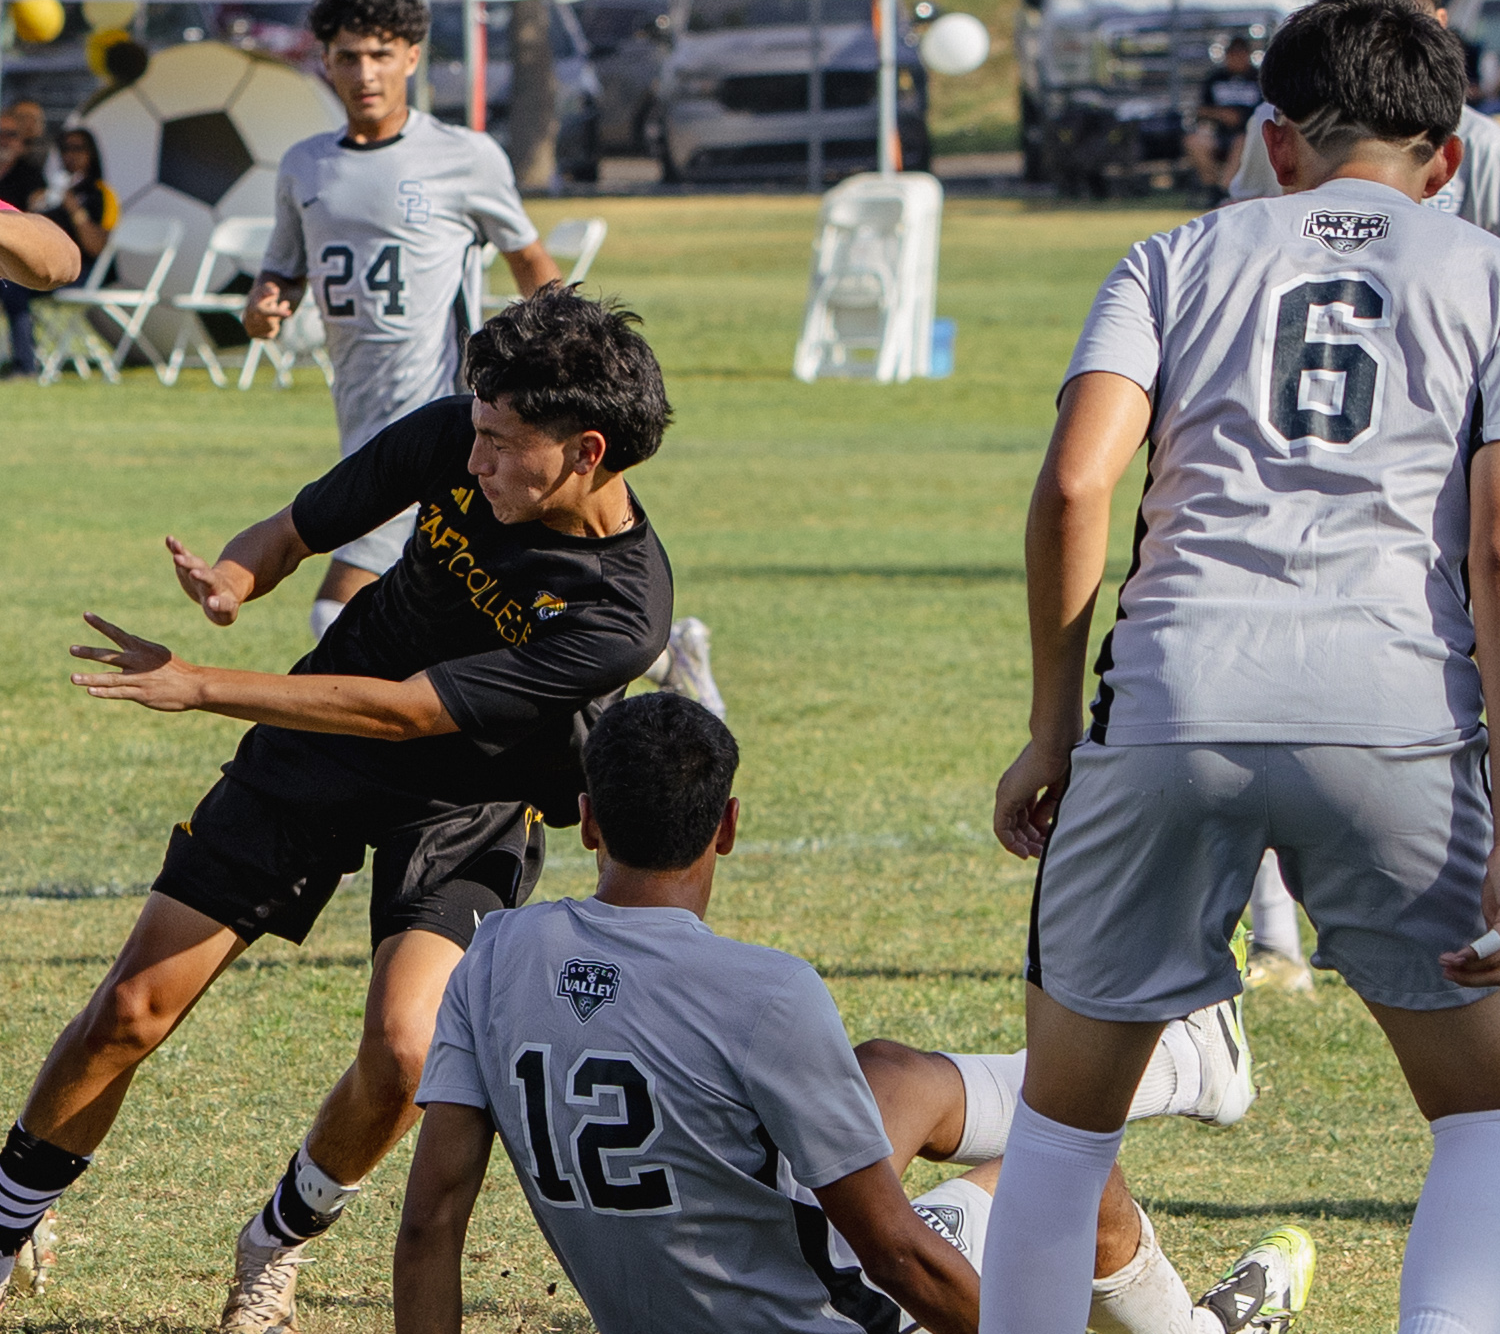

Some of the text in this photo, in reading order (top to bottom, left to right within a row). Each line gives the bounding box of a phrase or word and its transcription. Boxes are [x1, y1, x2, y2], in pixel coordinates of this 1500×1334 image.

[1318, 216, 1379, 226] SOCCER
[1311, 224, 1381, 239] VALLEY
[319, 242, 408, 319] 24
[1259, 271, 1392, 454] 6
[570, 966, 613, 979] SOCCER
[564, 978, 614, 997] VALLEY
[509, 1041, 682, 1216] 12
